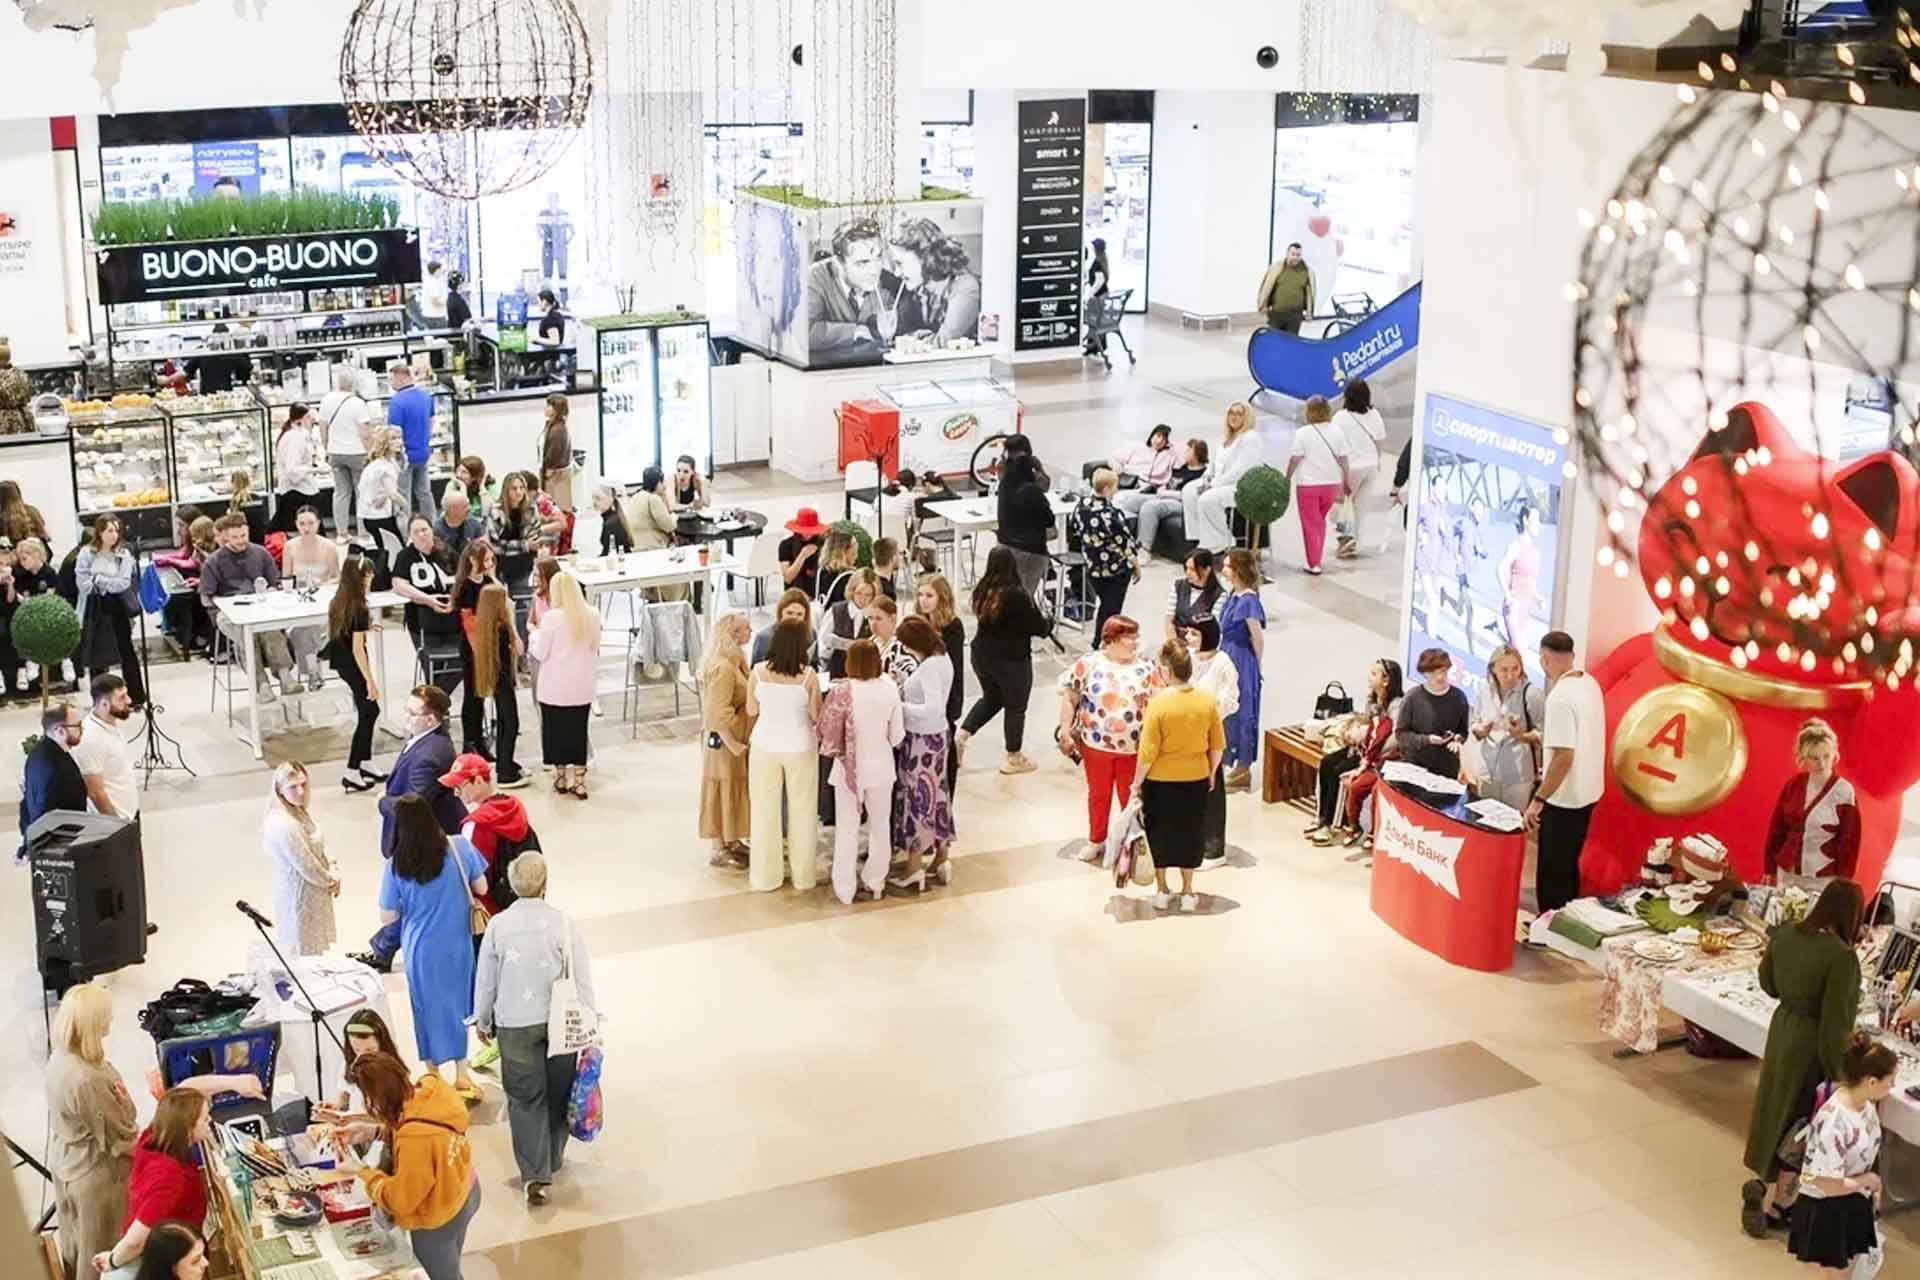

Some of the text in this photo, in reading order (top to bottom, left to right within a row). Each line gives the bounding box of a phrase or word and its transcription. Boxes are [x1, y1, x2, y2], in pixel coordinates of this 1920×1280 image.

[1036, 147, 1068, 159] smart
[142, 238, 378, 281] BUONO-BUONO
[248, 276, 278, 289] cafe
[1416, 839, 1449, 868] Банк
